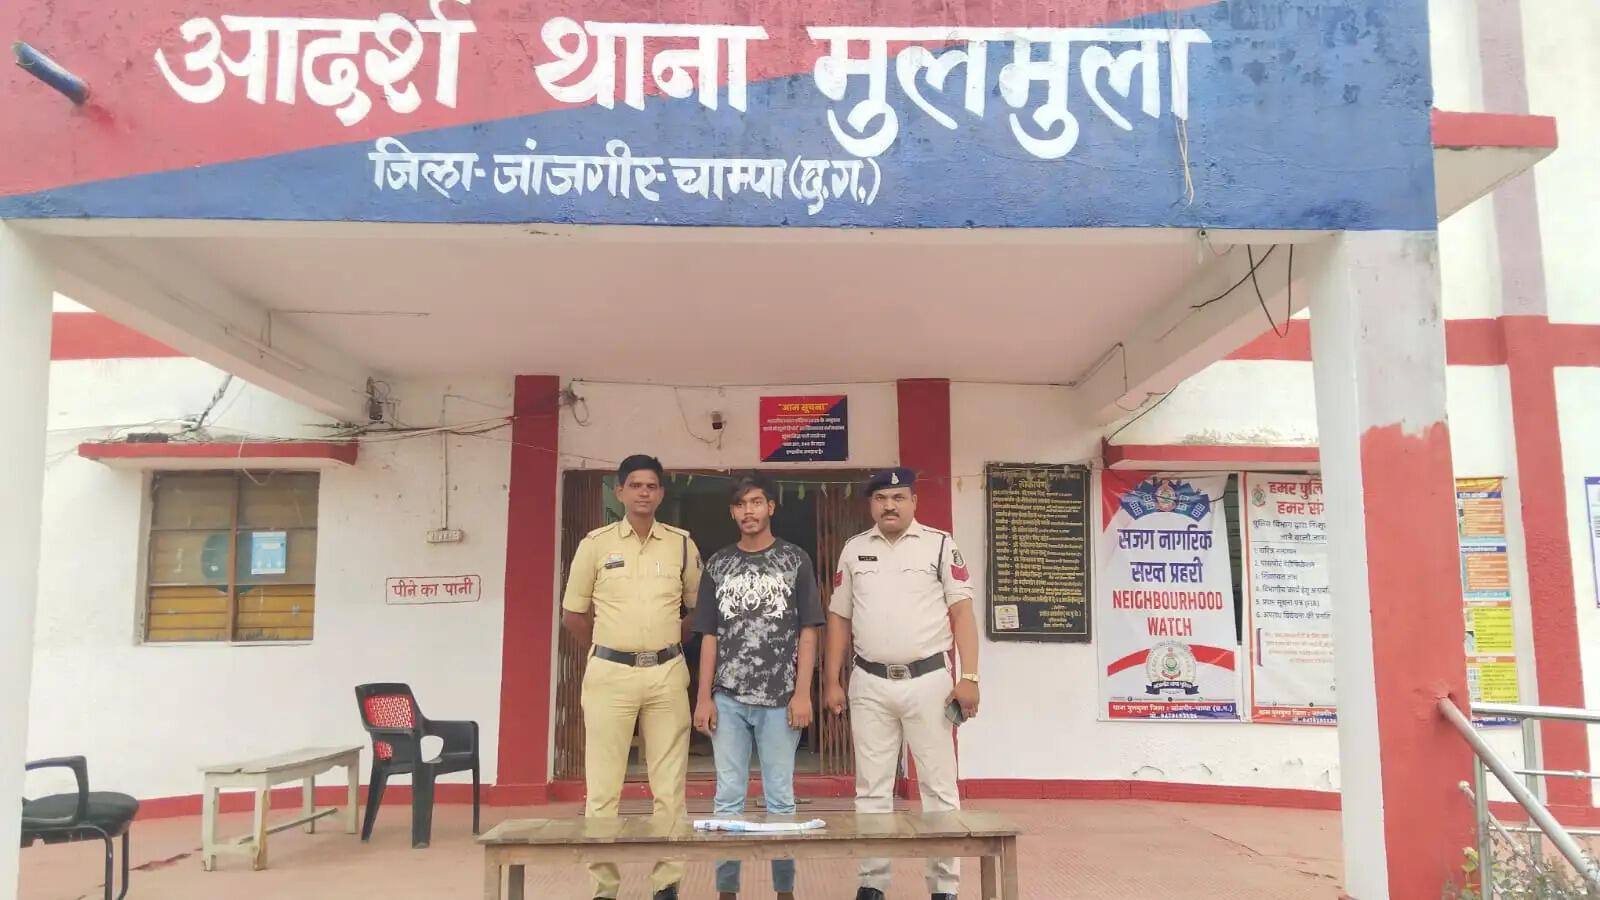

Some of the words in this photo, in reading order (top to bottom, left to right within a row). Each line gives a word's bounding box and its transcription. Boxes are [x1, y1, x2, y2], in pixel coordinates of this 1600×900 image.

[155, 0, 476, 126] आदर्श
[534, 16, 768, 112] थाना
[807, 26, 1212, 160] मुलमुला
[1267, 481, 1297, 495] हमर
[1299, 478, 1323, 499] पुलि
[1276, 501, 1304, 515] हमर
[1117, 528, 1155, 551] सजग
[1158, 523, 1213, 551] नागरिक
[1169, 556, 1203, 583] प्रहरी
[392, 579, 418, 597] पीने
[420, 583, 440, 597] का
[442, 577, 473, 596] पानी
[1112, 590, 1223, 610] NEIGHBOURHOOD
[1147, 617, 1192, 637] WATCH
